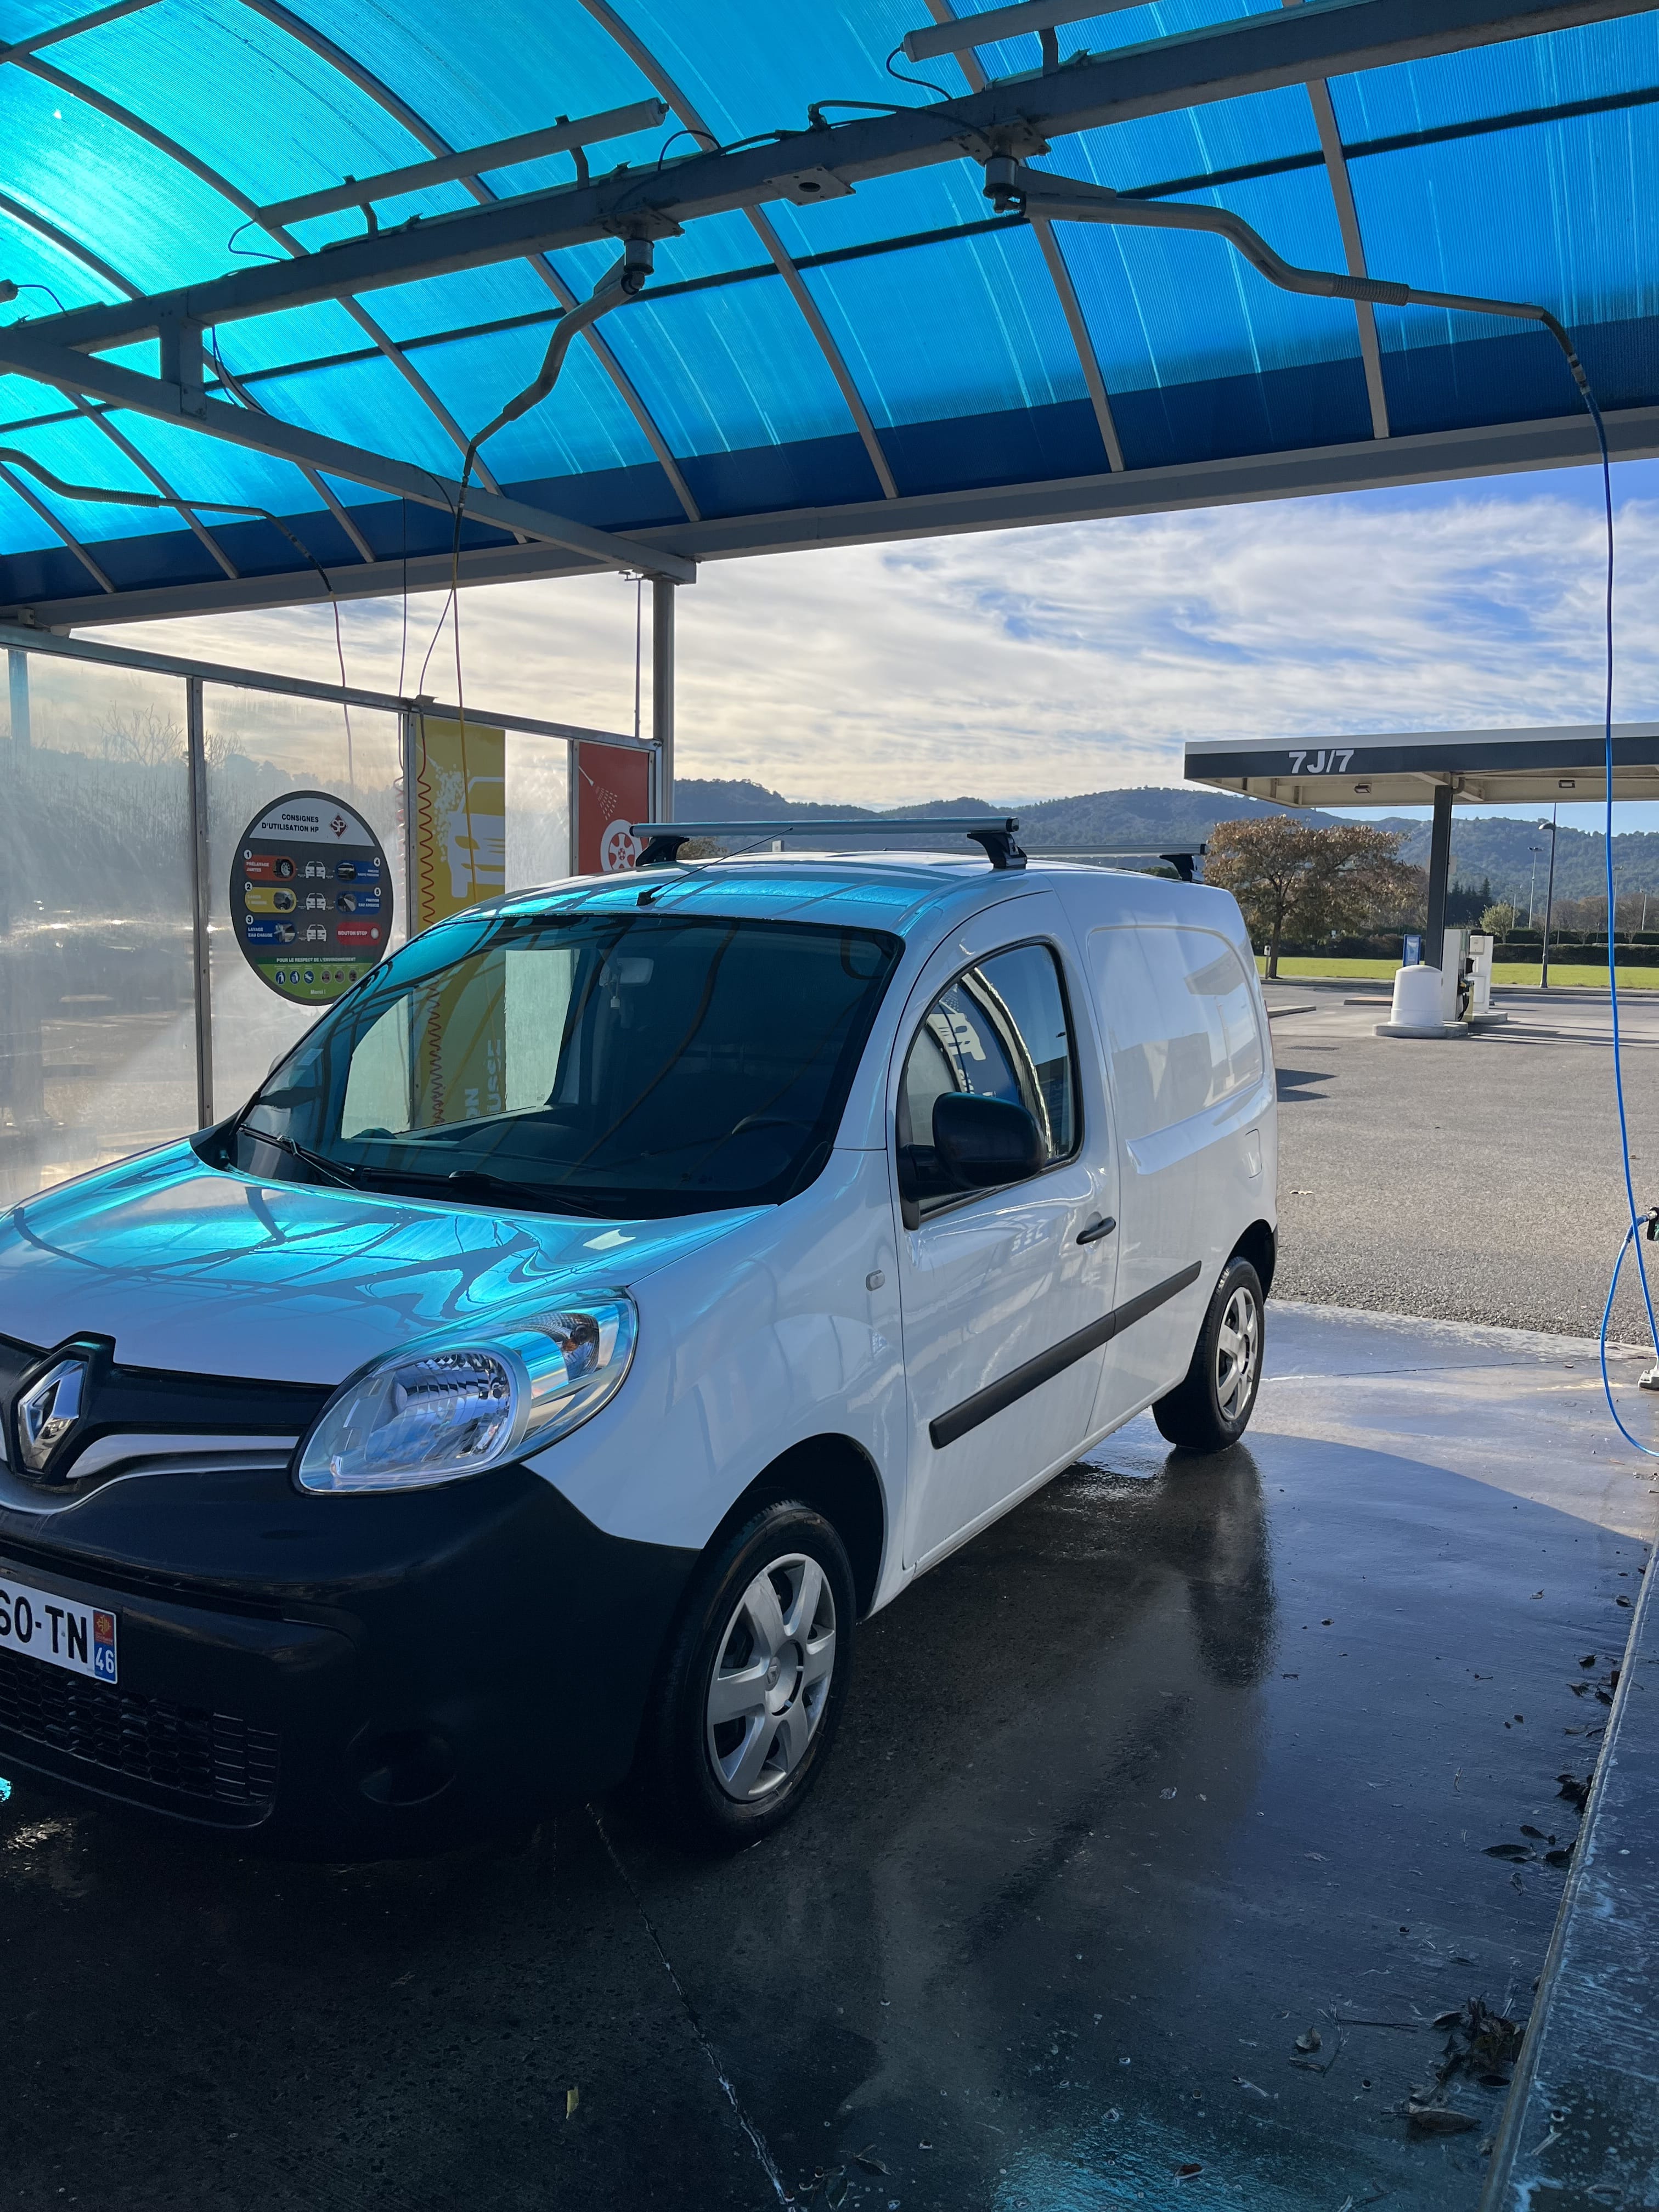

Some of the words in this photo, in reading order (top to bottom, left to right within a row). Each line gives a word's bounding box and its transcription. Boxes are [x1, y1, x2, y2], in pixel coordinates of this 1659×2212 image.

[1289, 749, 1354, 774] 7J/7
[281, 814, 319, 823] CONSIGNES
[262, 822, 308, 832] D'UTILISATION
[332, 820, 345, 833] SP
[95, 1647, 115, 1674] 46
